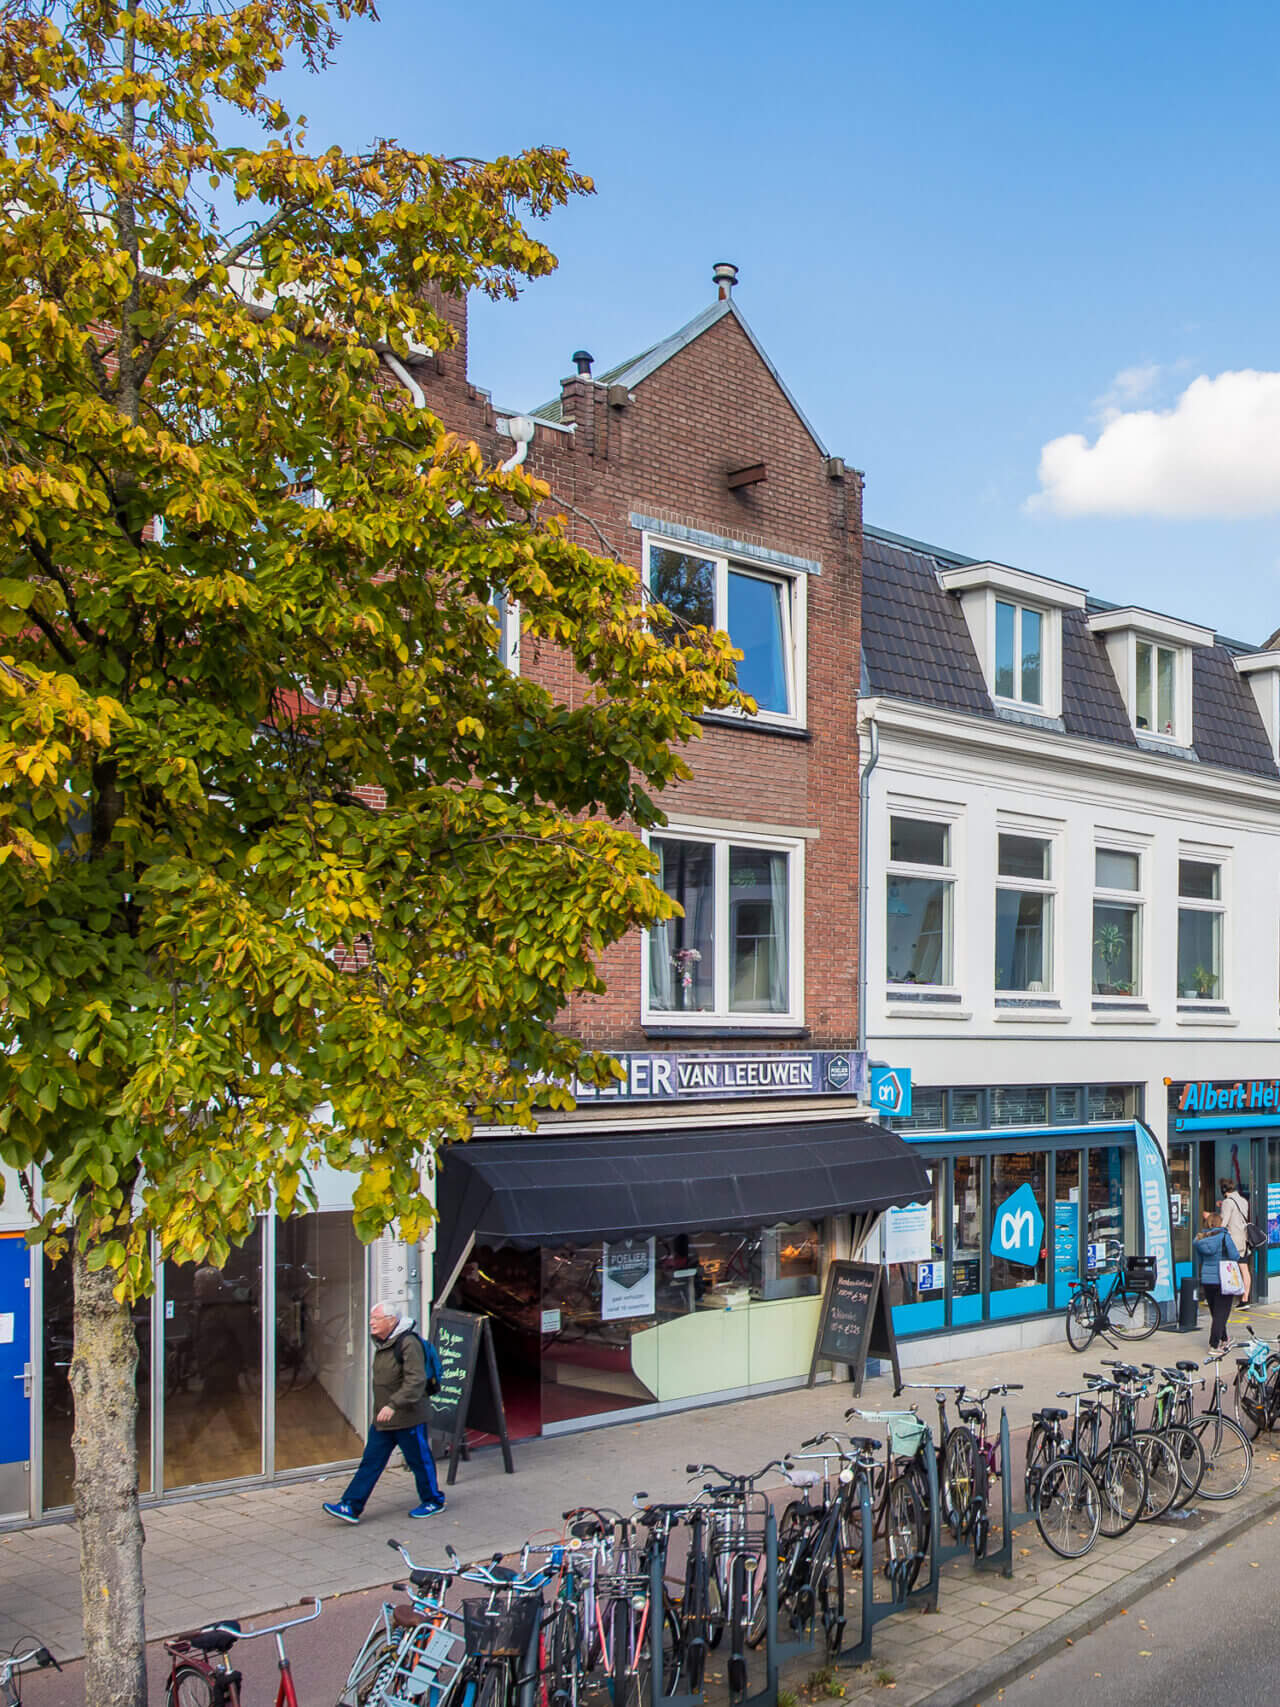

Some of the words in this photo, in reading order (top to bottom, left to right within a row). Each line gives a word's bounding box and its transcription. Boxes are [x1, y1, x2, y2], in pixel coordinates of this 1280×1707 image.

[678, 1064, 718, 1087] VAN
[724, 1062, 813, 1086] LEEUWEN
[1179, 1082, 1246, 1110] Albert
